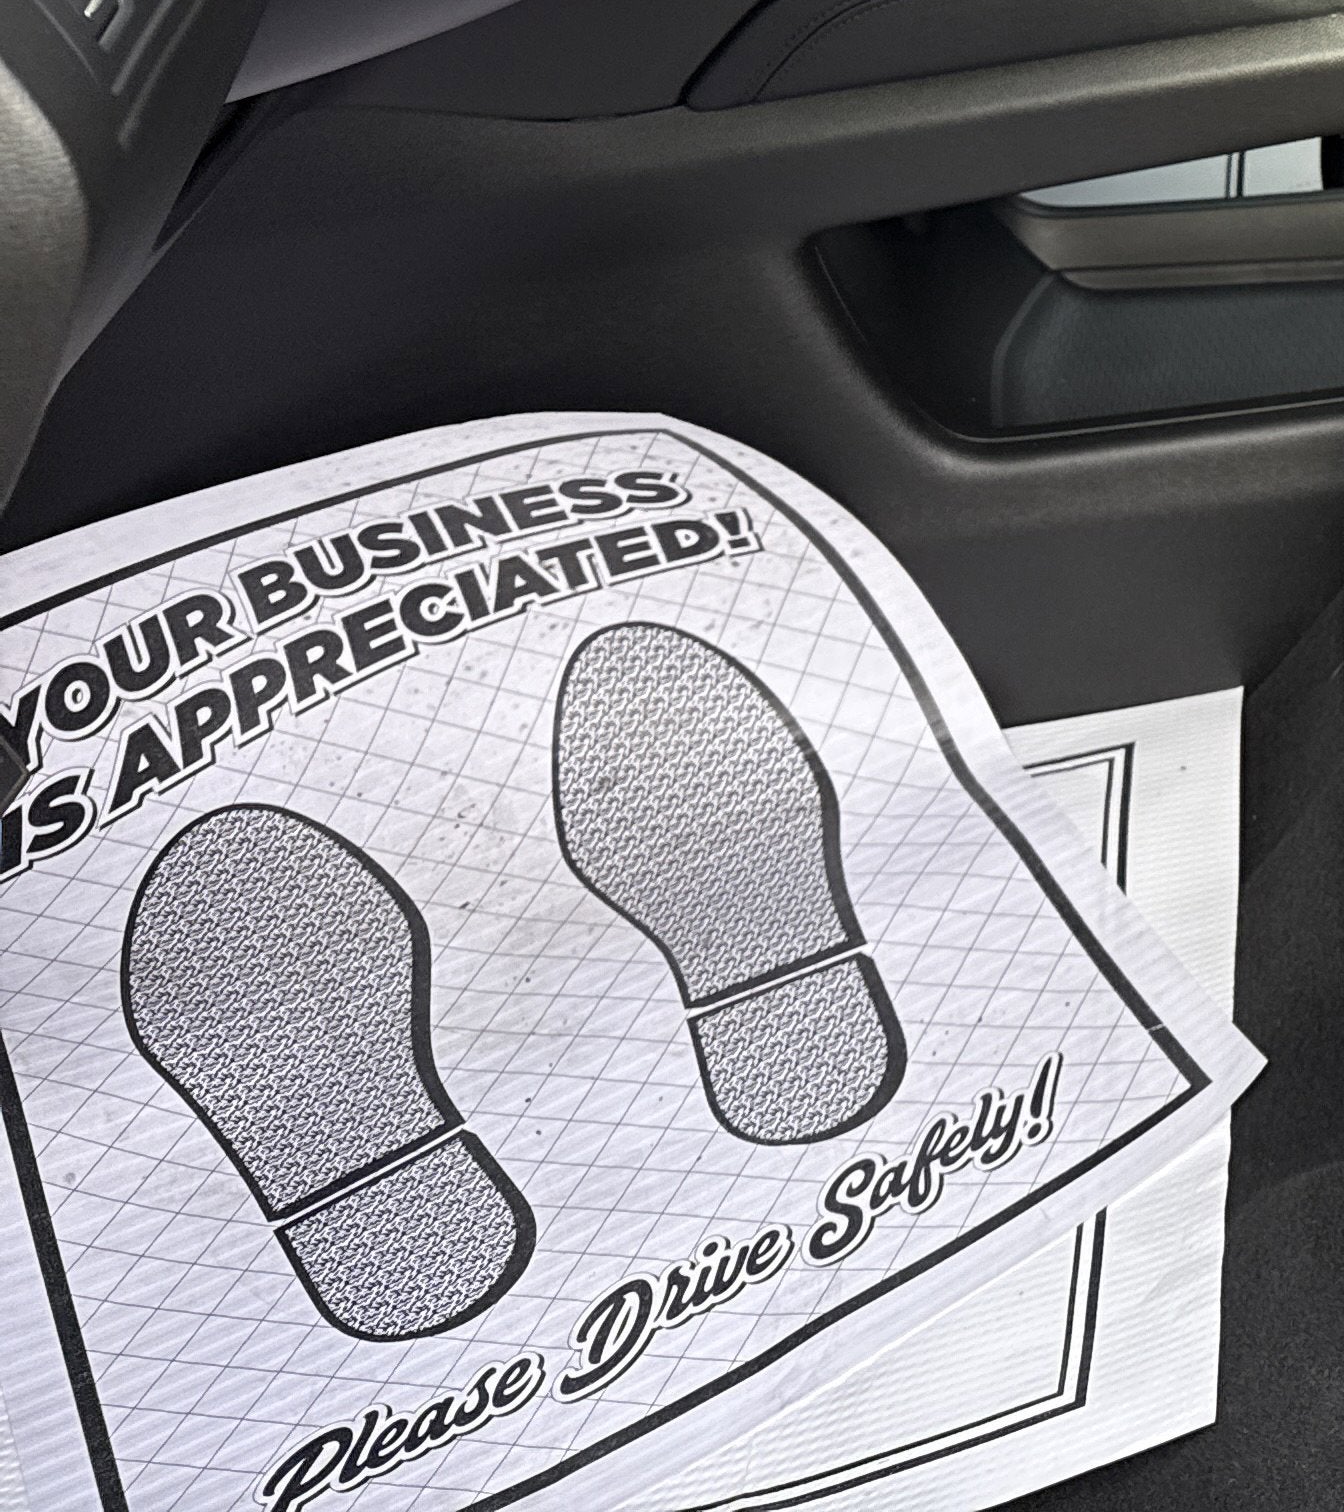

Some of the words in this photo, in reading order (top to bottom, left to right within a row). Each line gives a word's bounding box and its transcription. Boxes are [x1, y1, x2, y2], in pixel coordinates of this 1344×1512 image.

[0, 593, 254, 774] YOUR
[236, 471, 690, 630] BUSINESS
[0, 769, 97, 882] IS
[103, 510, 757, 821] APPRECIATED!
[262, 1352, 542, 1512] Please
[560, 1225, 793, 1397] Drive
[804, 1053, 1062, 1266] Safely!
